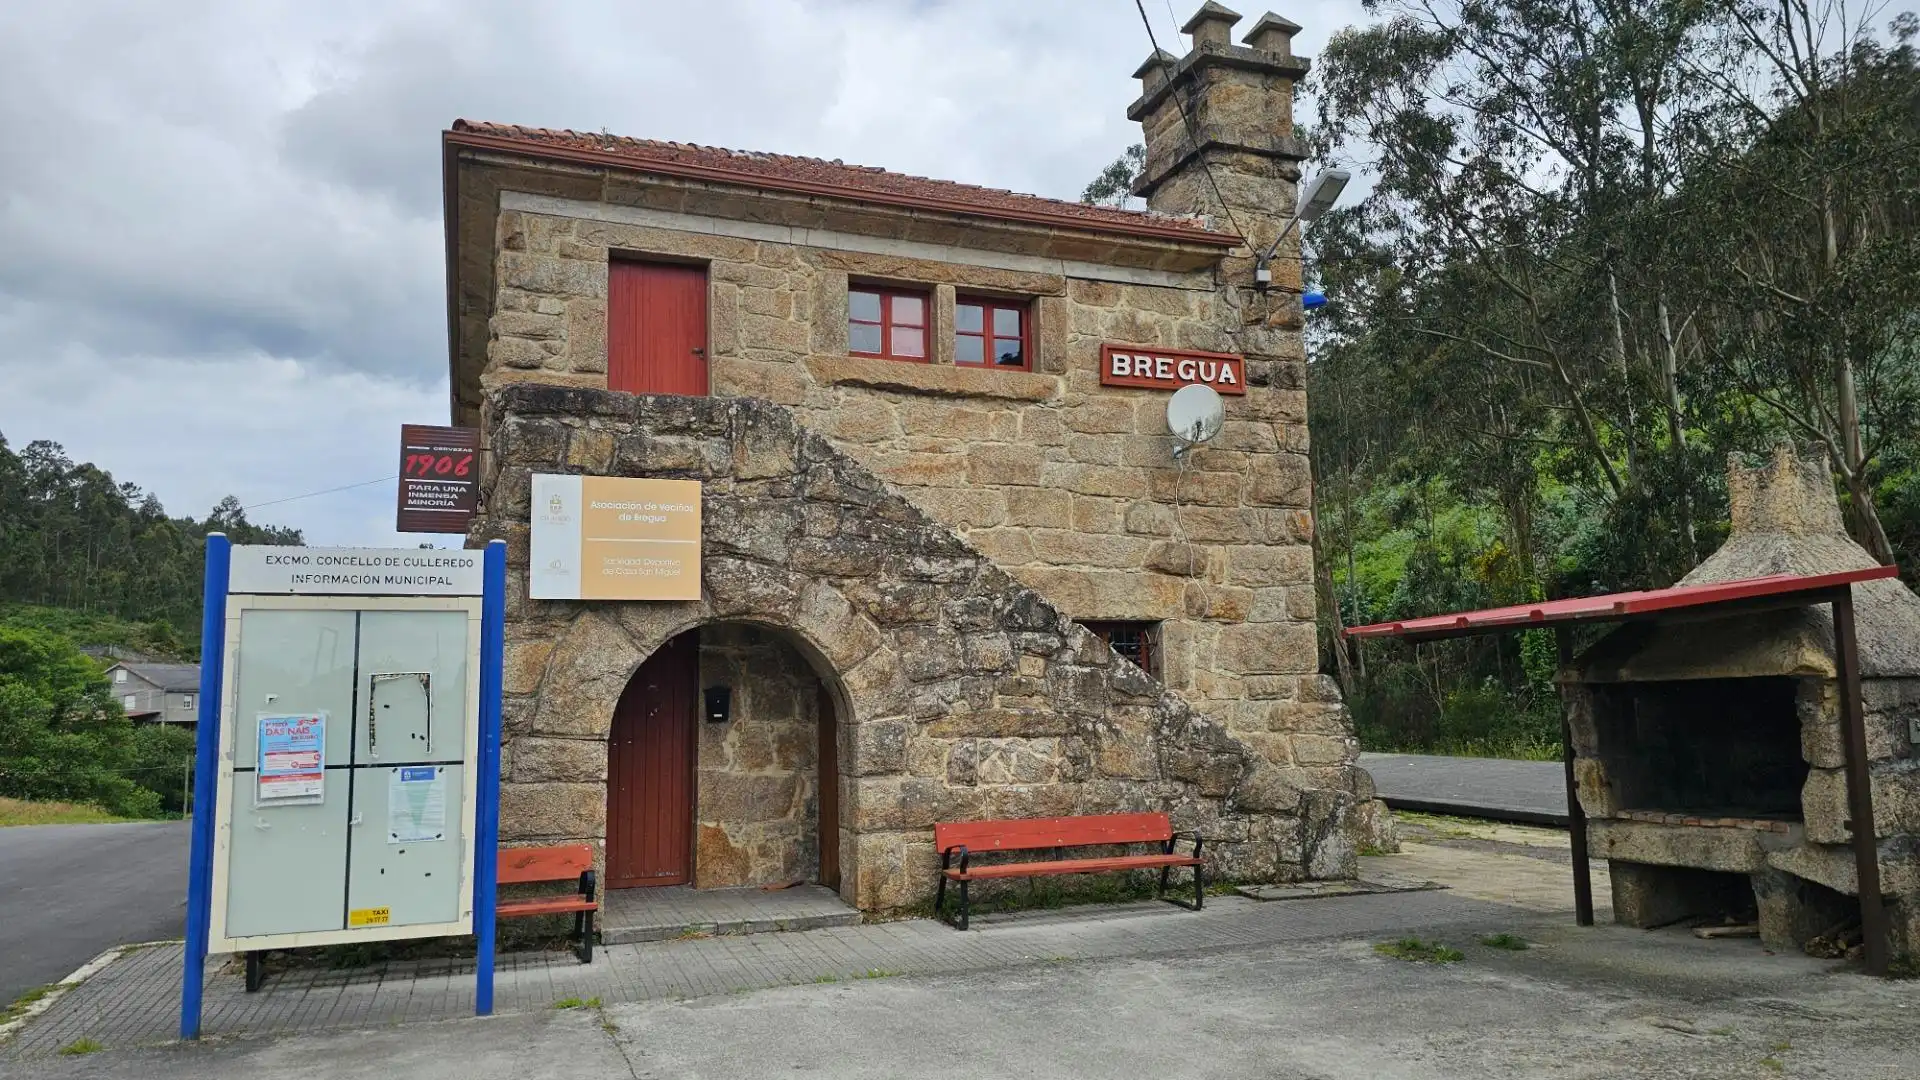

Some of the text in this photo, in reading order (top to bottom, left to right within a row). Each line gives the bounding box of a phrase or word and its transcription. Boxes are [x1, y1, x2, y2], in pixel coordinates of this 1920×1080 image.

[1112, 353, 1237, 384] BREGUA
[405, 454, 473, 476] 1906
[644, 502, 658, 511] de
[266, 555, 474, 568] EXCMO. CONCELLO DE CULLEREDO
[291, 573, 453, 586] INFORMACIÓN MUNICIPAL
